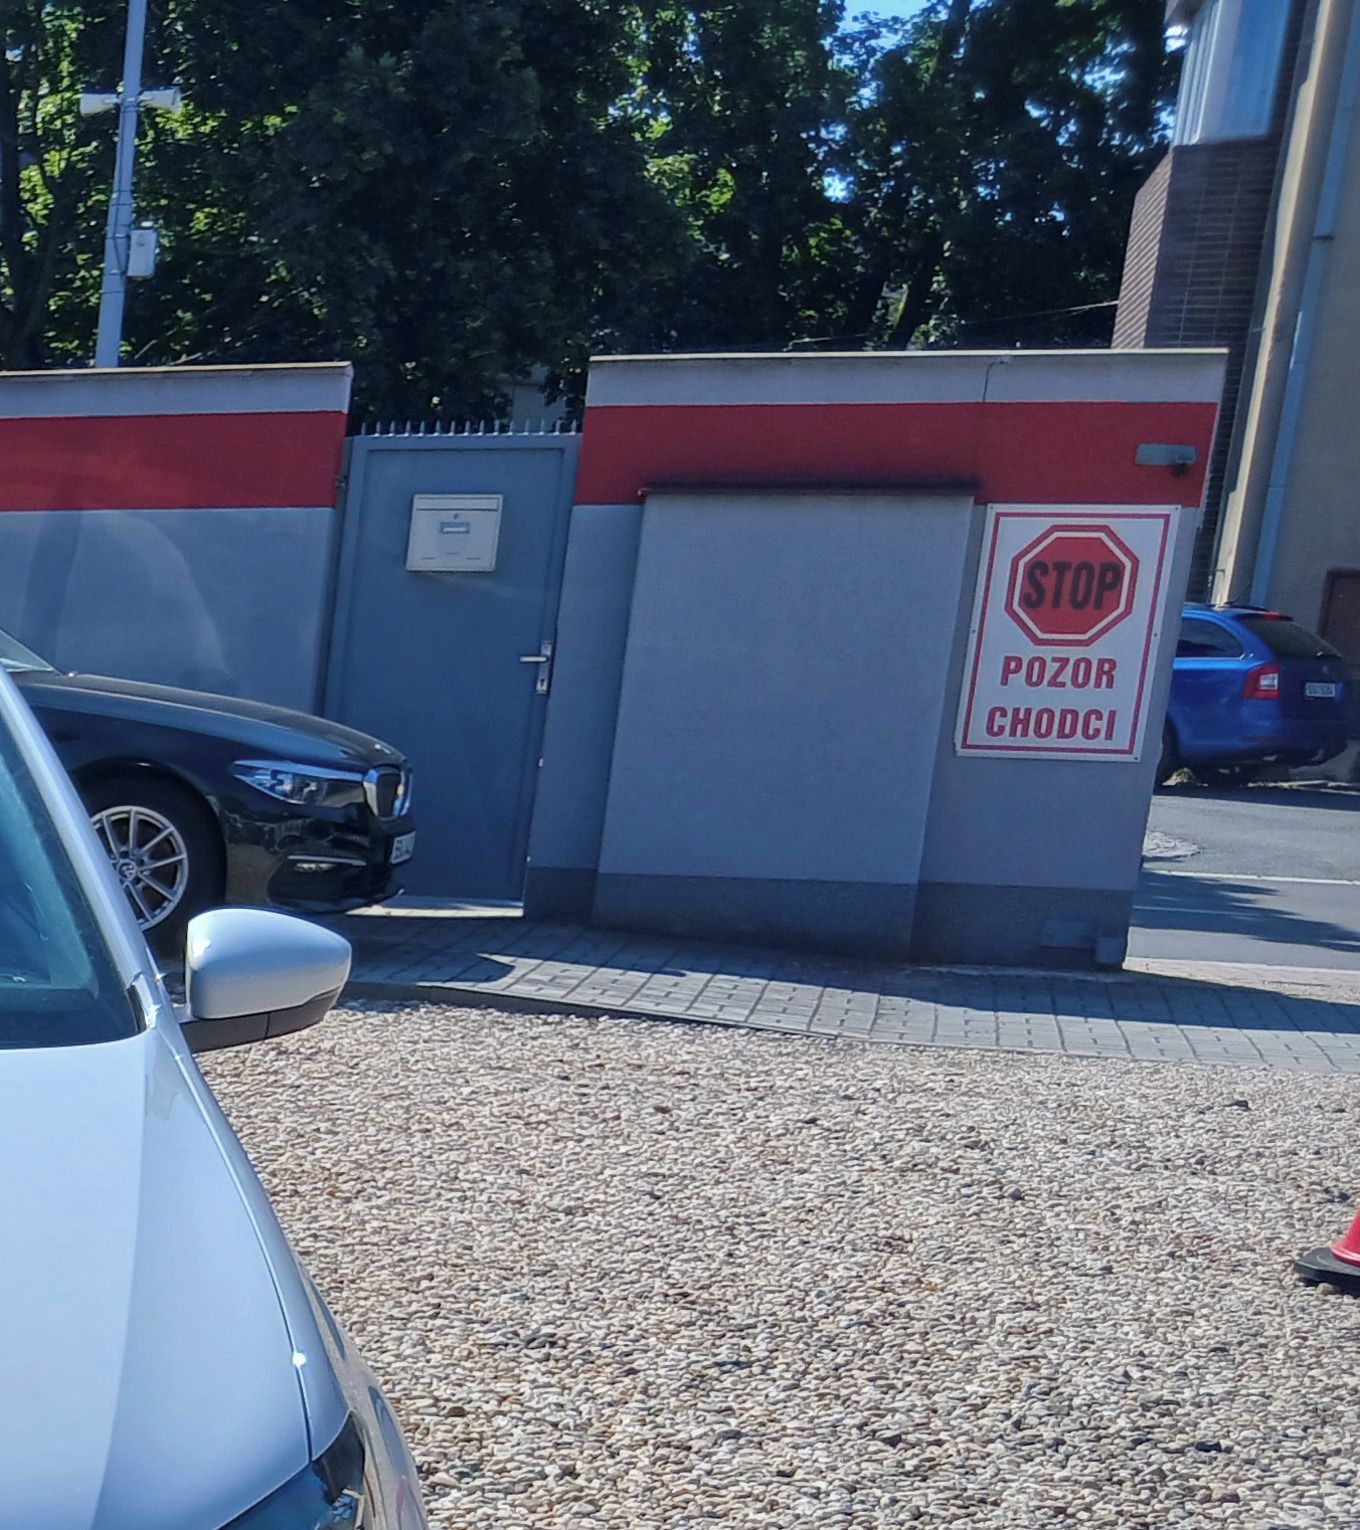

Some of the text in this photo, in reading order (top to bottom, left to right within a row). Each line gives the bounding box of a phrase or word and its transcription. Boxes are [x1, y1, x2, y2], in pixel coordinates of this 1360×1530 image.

[1023, 560, 1122, 611] STOP
[1000, 656, 1117, 689] POZOR
[985, 706, 1117, 741] CHODCI
